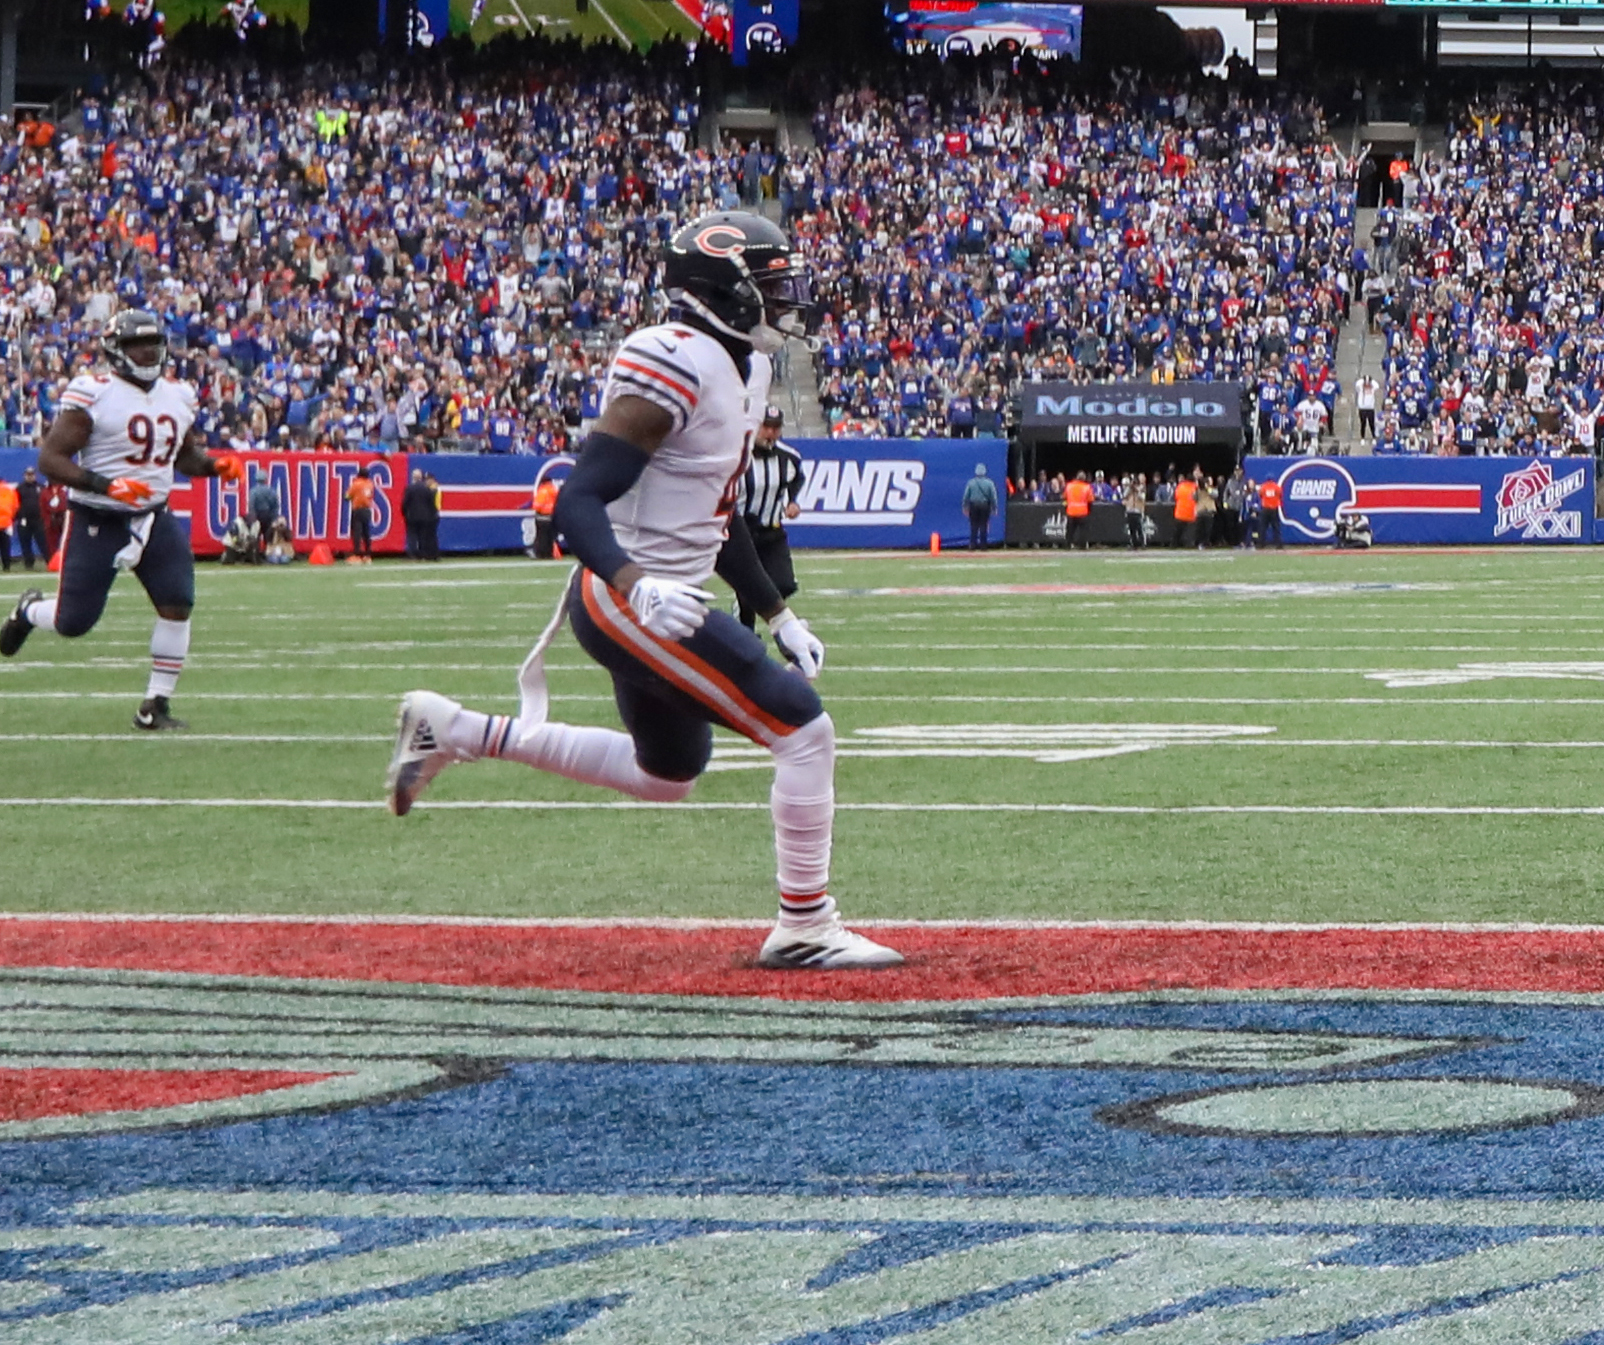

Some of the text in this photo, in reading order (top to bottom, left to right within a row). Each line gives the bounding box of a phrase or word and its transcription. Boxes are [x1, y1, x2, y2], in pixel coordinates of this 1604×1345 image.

[1036, 395, 1226, 417] Modelo
[126, 414, 178, 466] 93
[1068, 425, 1196, 444] METLIFE STADIUM
[1290, 479, 1337, 496] GIANTS
[1522, 511, 1581, 538] XXI
